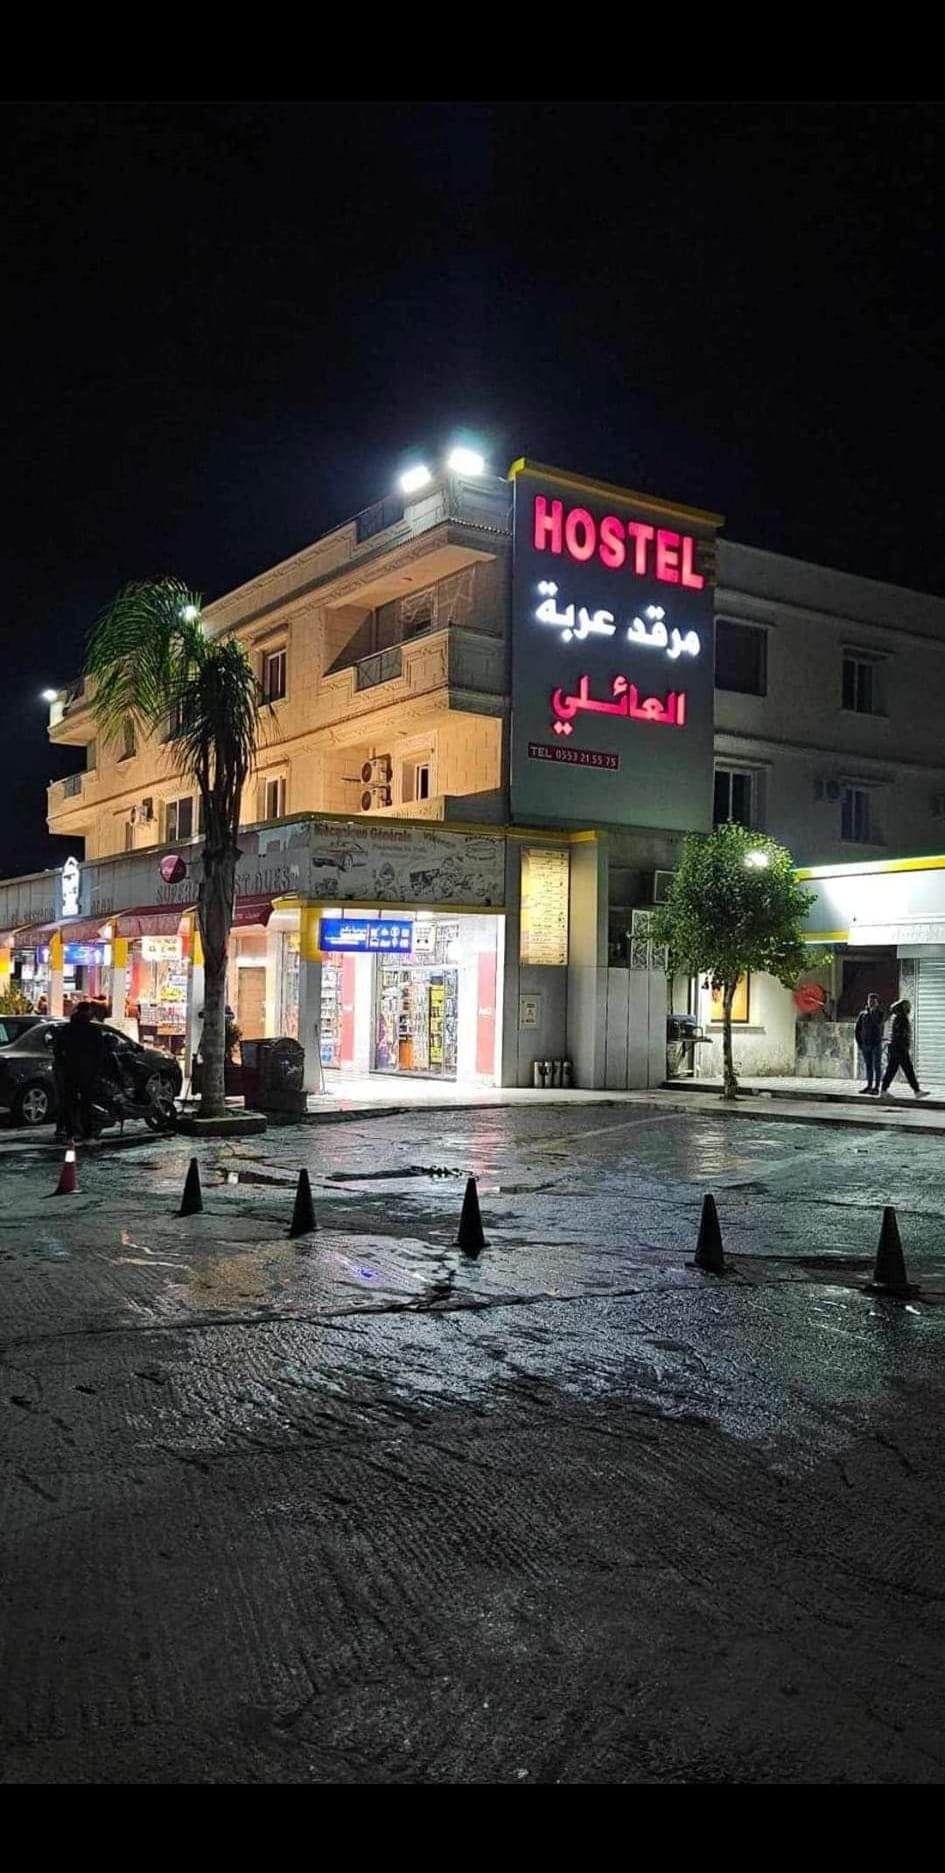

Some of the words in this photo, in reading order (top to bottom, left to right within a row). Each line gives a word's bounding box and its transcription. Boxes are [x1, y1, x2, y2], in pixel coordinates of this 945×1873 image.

[533, 495, 705, 590] HOSTEL
[535, 579, 617, 644] عربة
[627, 604, 701, 659] مرقد
[552, 673, 686, 736] العائلي
[555, 749, 578, 762] 0553
[580, 753, 590, 763] 21
[592, 755, 603, 766] 55
